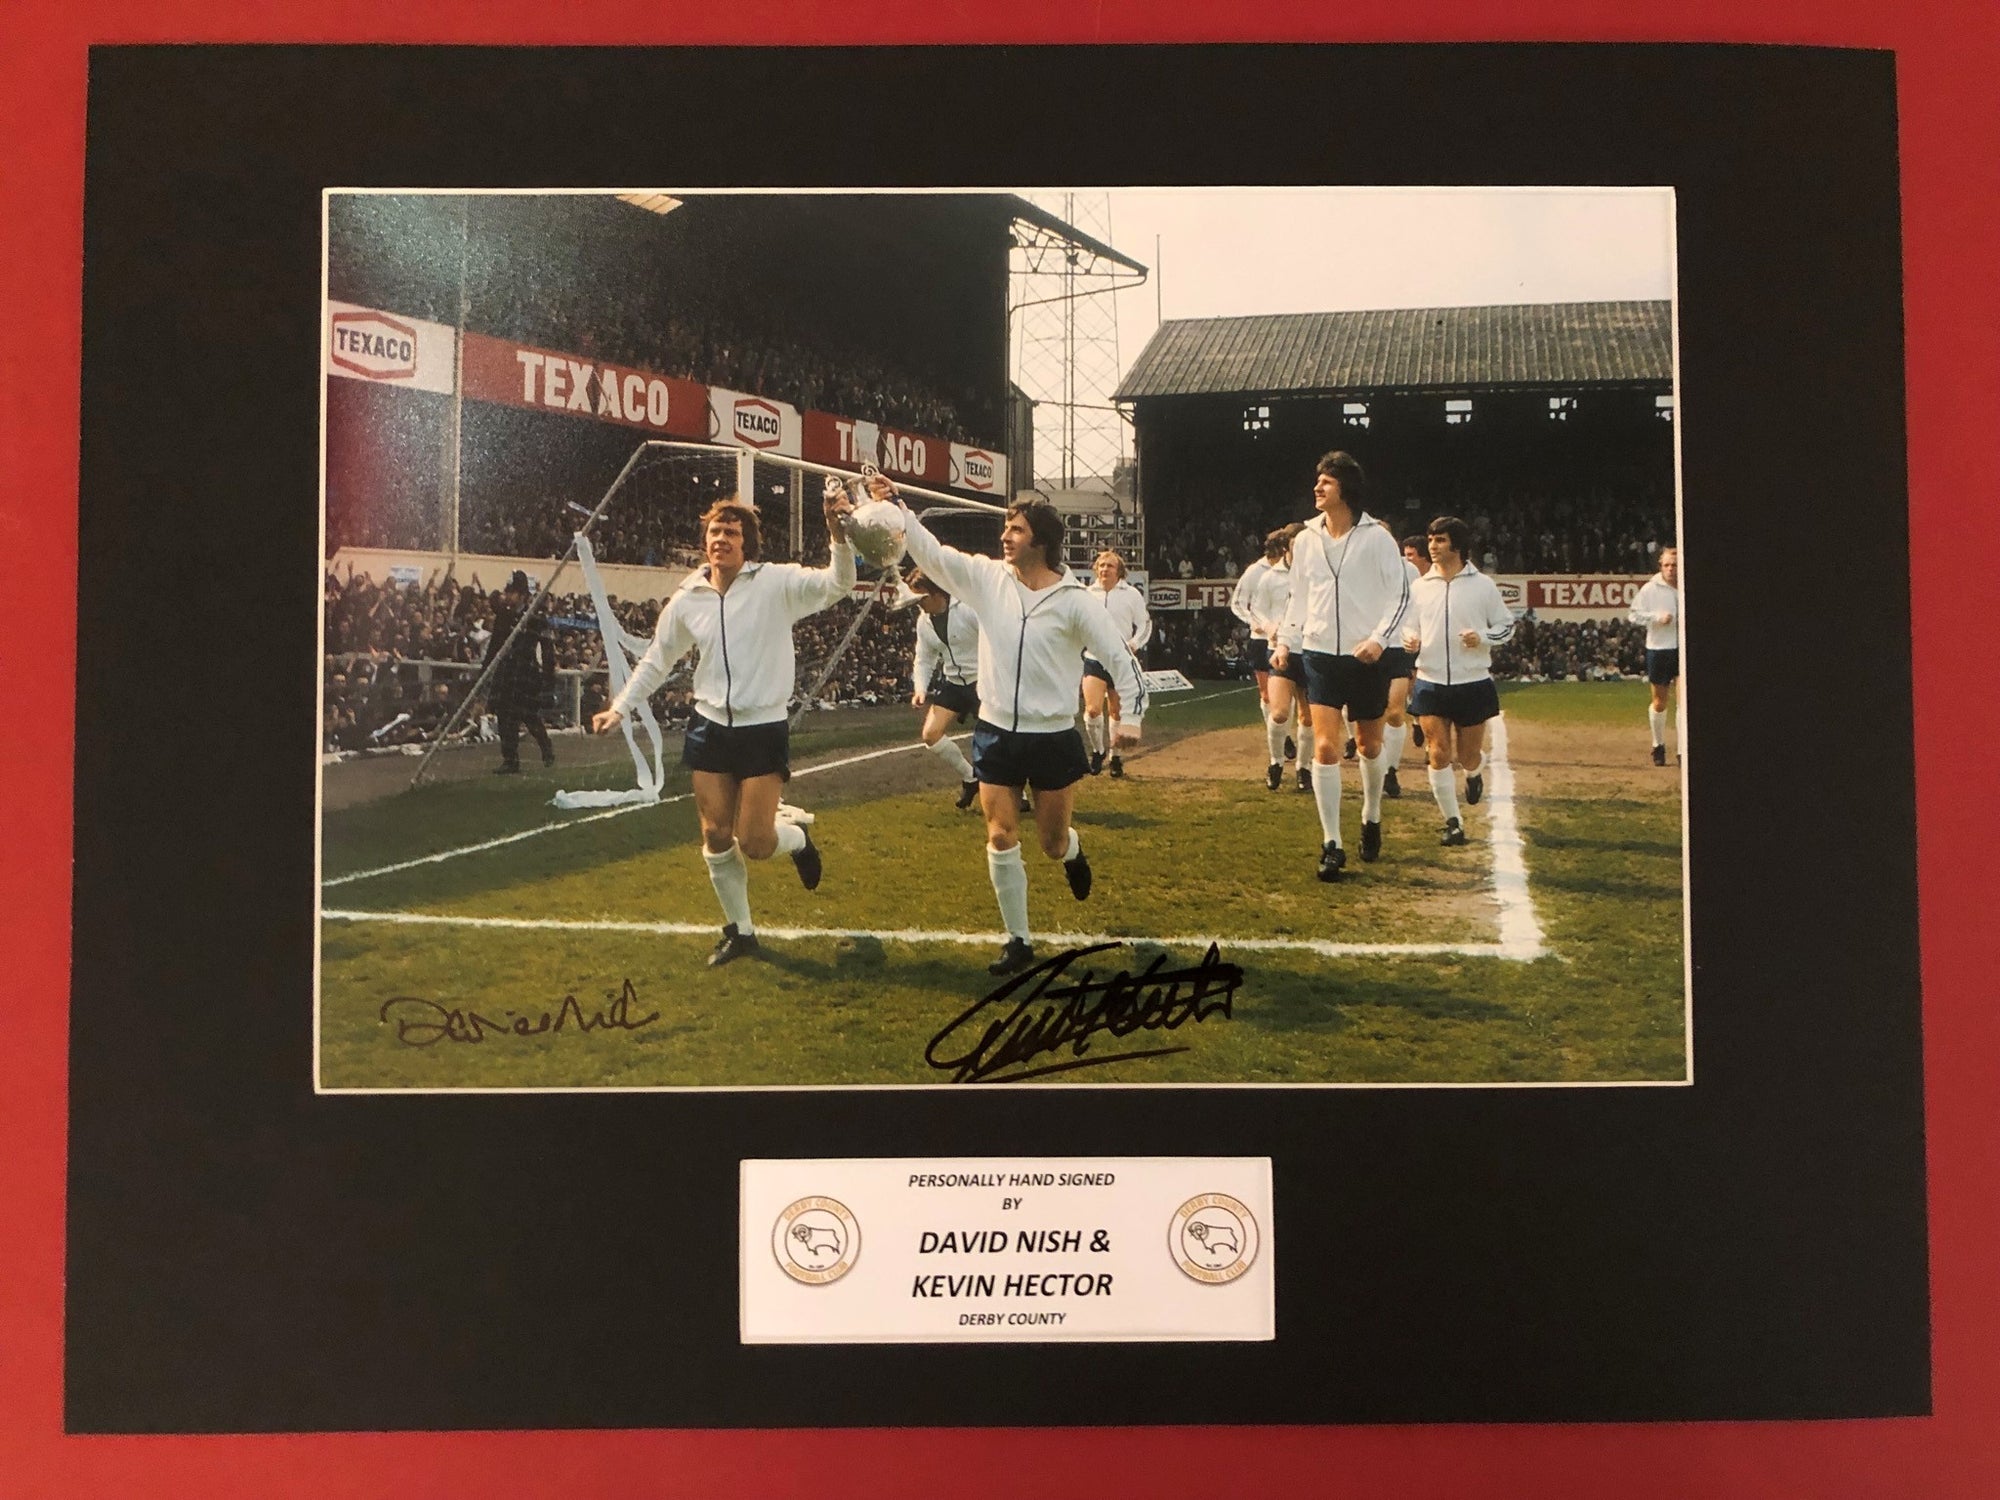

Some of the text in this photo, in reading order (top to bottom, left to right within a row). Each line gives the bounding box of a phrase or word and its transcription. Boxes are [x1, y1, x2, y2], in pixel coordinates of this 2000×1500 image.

[336, 327, 412, 364] TEXACO
[516, 350, 669, 427] TEXACO
[735, 410, 778, 436] TEXACO
[835, 421, 926, 476] TACO
[965, 460, 993, 480] TEXACO
[1149, 592, 1179, 602] TEXACO
[1501, 589, 1519, 598] ACO
[1540, 583, 1639, 605] TEXACO
[908, 1173, 1115, 1187] PERSONALLY HAND SIGNED
[1002, 1197, 1022, 1210] BY
[919, 1229, 1110, 1254] DAVID NISH &
[912, 1273, 1113, 1298] KEVIN HECTOR
[959, 1312, 1066, 1326] DERBY COUNTY
